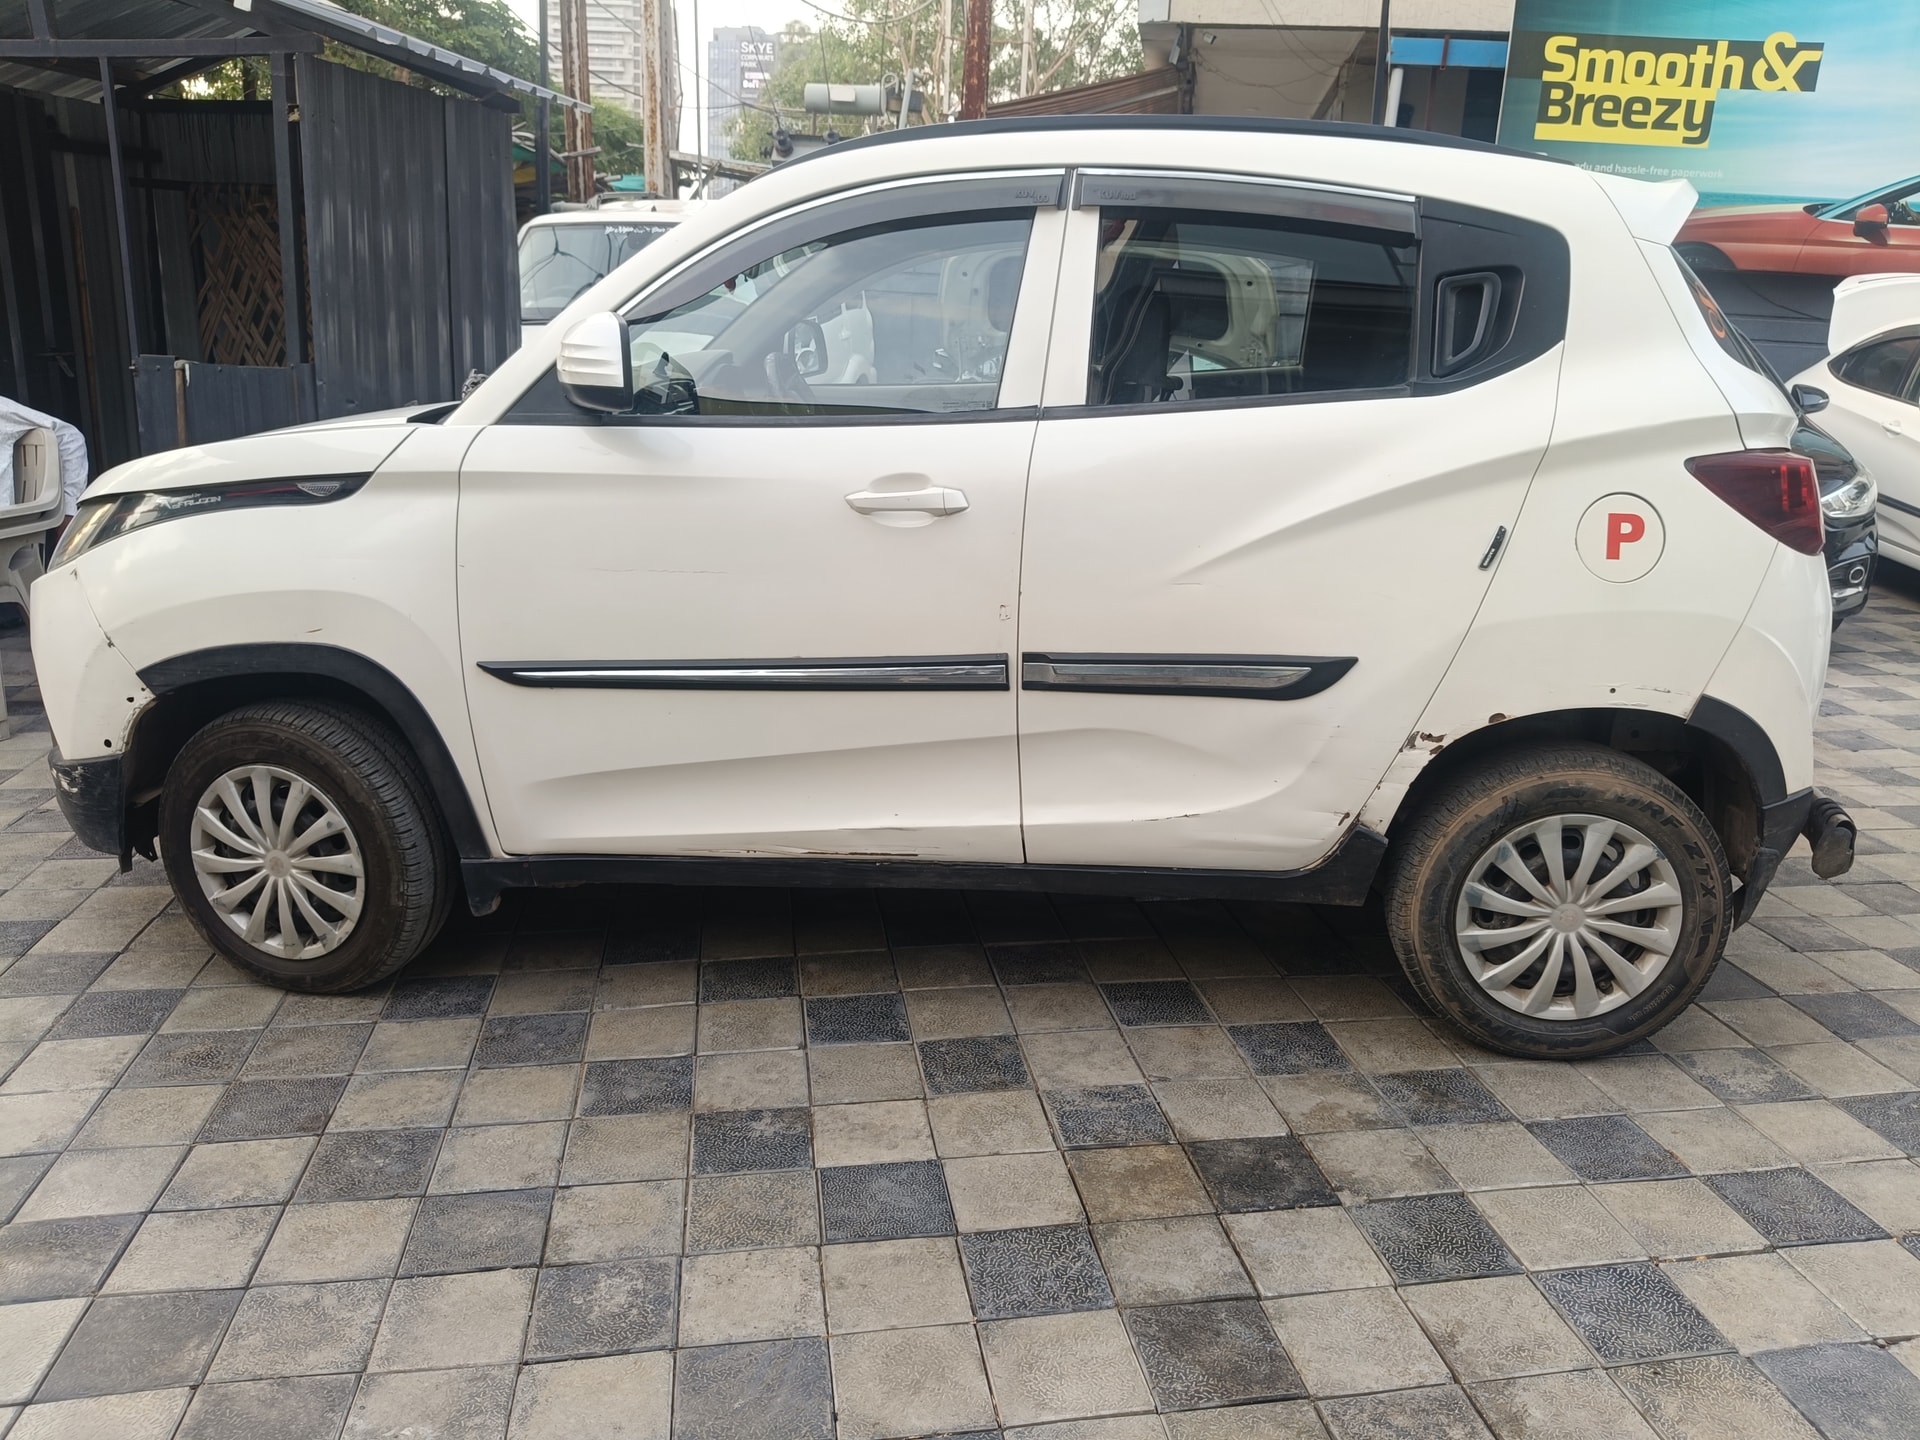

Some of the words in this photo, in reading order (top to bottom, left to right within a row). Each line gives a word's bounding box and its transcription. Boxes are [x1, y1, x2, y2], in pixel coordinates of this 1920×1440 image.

[741, 41, 774, 54] SKYE
[1542, 35, 1745, 90] Smooth
[1751, 31, 1823, 92] &
[1537, 80, 1716, 145] Breezy
[1594, 163, 1613, 173] and
[1614, 164, 1669, 177] hassle-free
[1671, 169, 1724, 180] paperwork
[1606, 513, 1645, 560] P
